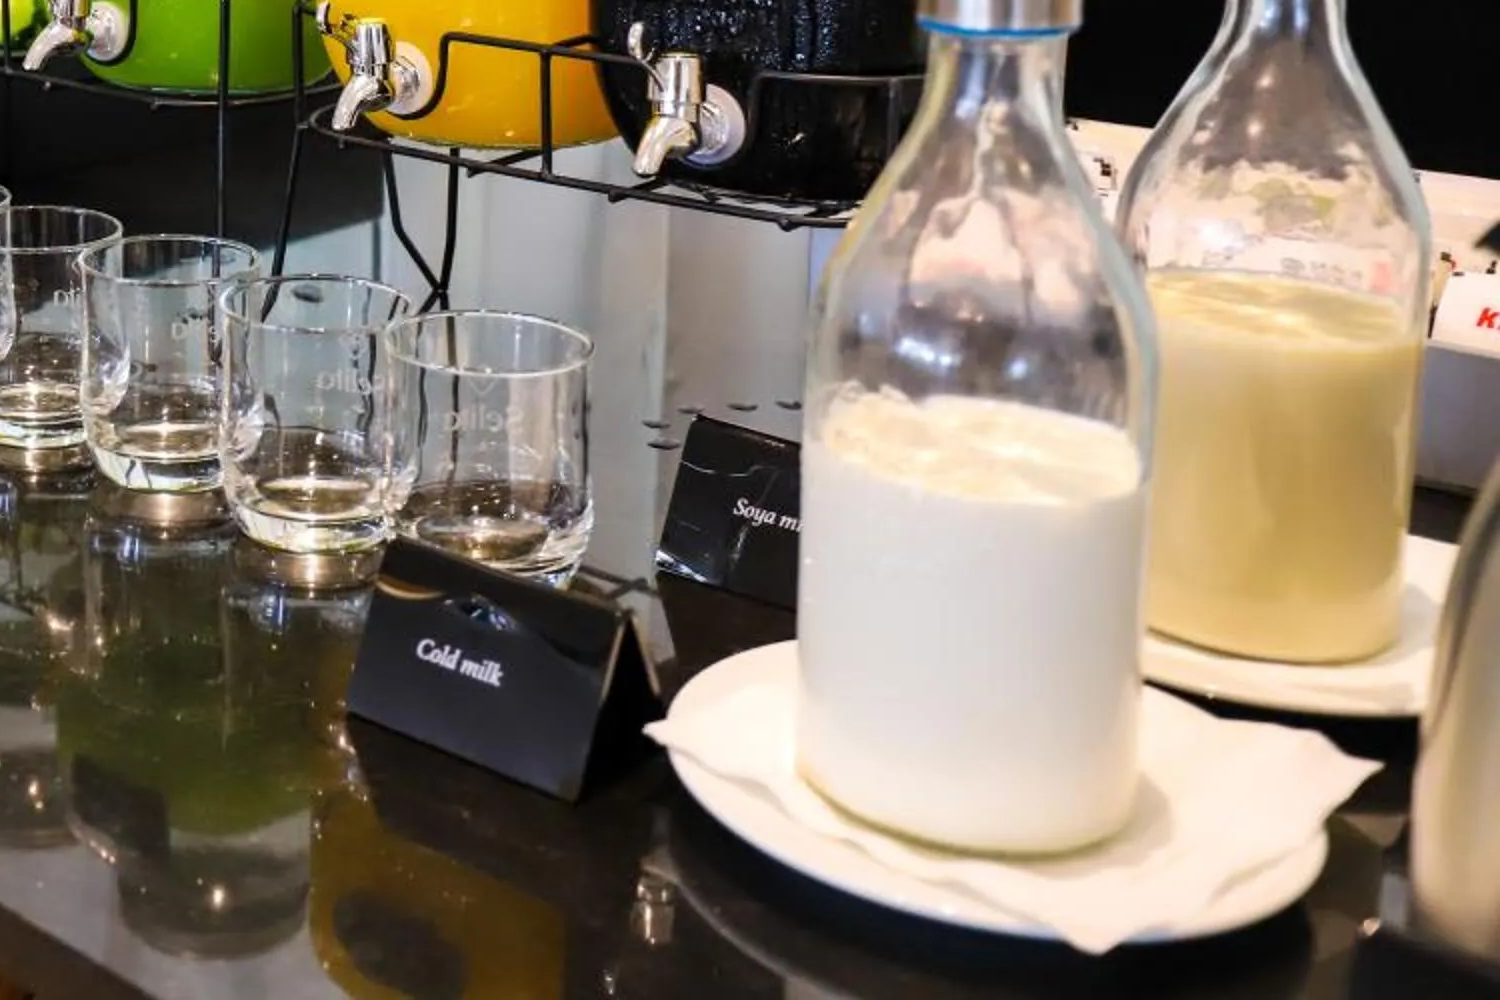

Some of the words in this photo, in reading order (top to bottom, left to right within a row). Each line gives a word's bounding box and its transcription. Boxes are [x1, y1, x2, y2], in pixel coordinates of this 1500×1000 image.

[733, 497, 777, 527] Soya
[778, 514, 805, 533] mi
[415, 637, 461, 670] Cold
[460, 659, 504, 687] milk
